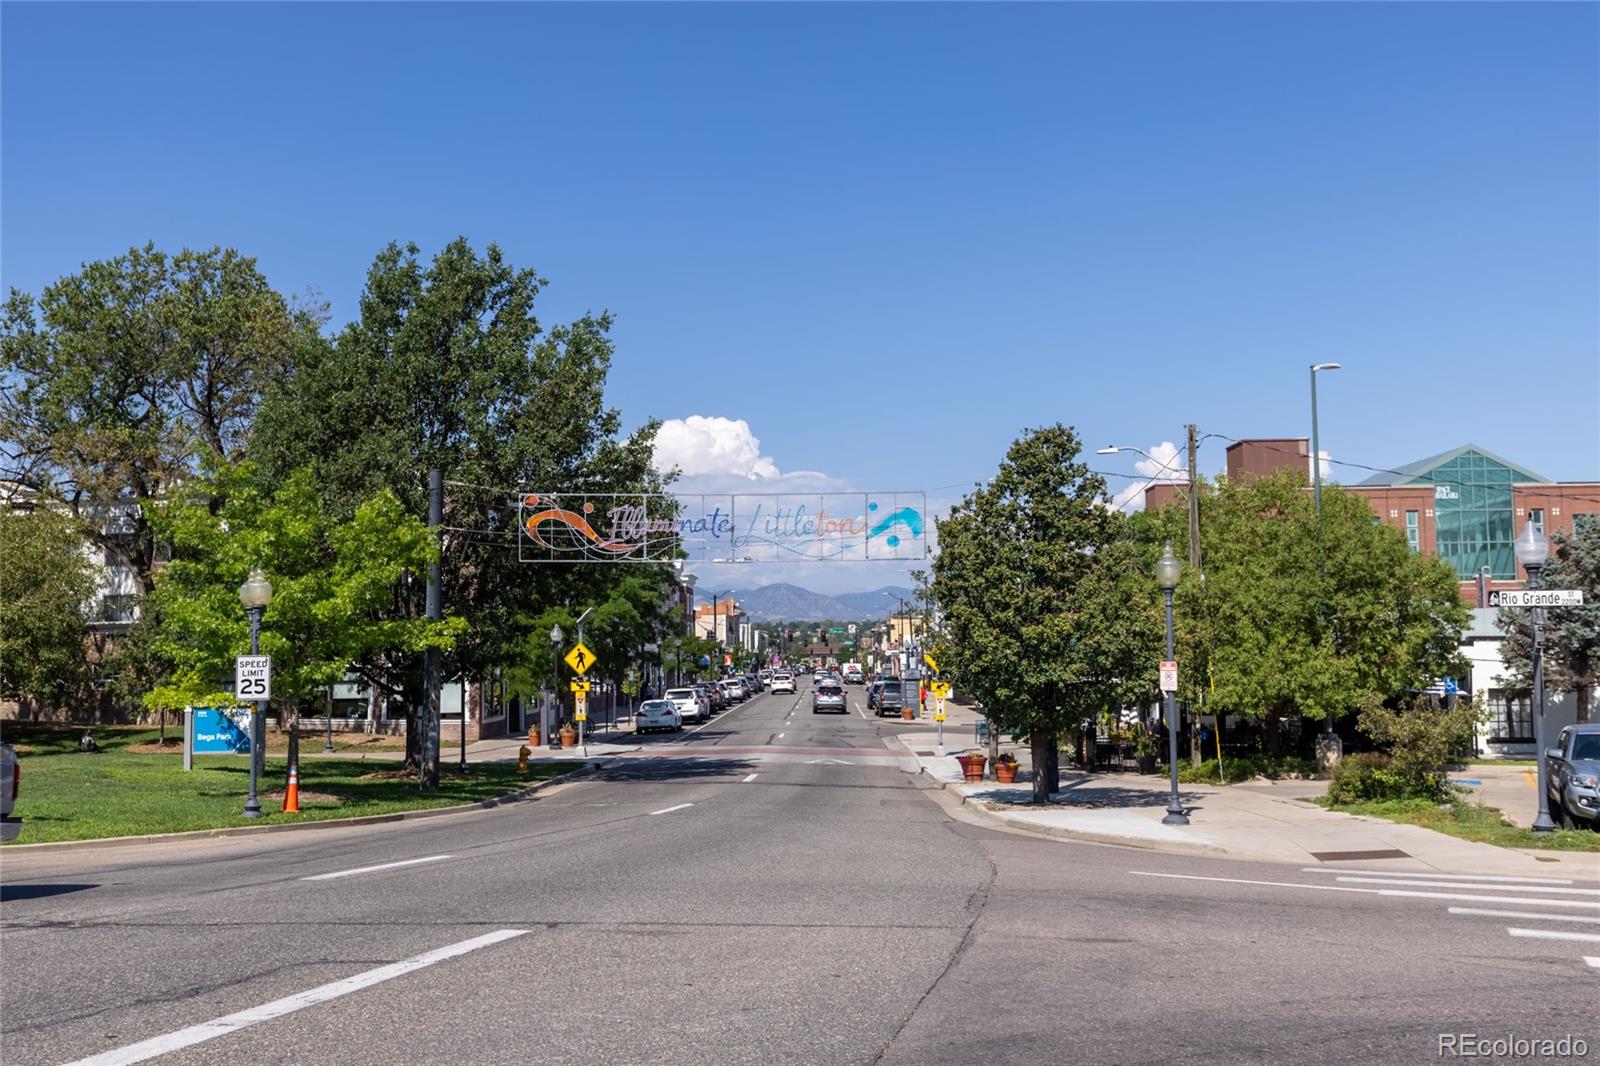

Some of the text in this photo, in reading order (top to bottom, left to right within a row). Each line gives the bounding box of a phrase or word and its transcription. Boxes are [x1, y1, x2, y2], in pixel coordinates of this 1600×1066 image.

[734, 503, 868, 547] Littleton
[1501, 593, 1518, 604] Rio
[1523, 593, 1560, 604] Grande
[240, 679, 266, 694] 25
[197, 734, 214, 742] Bega
